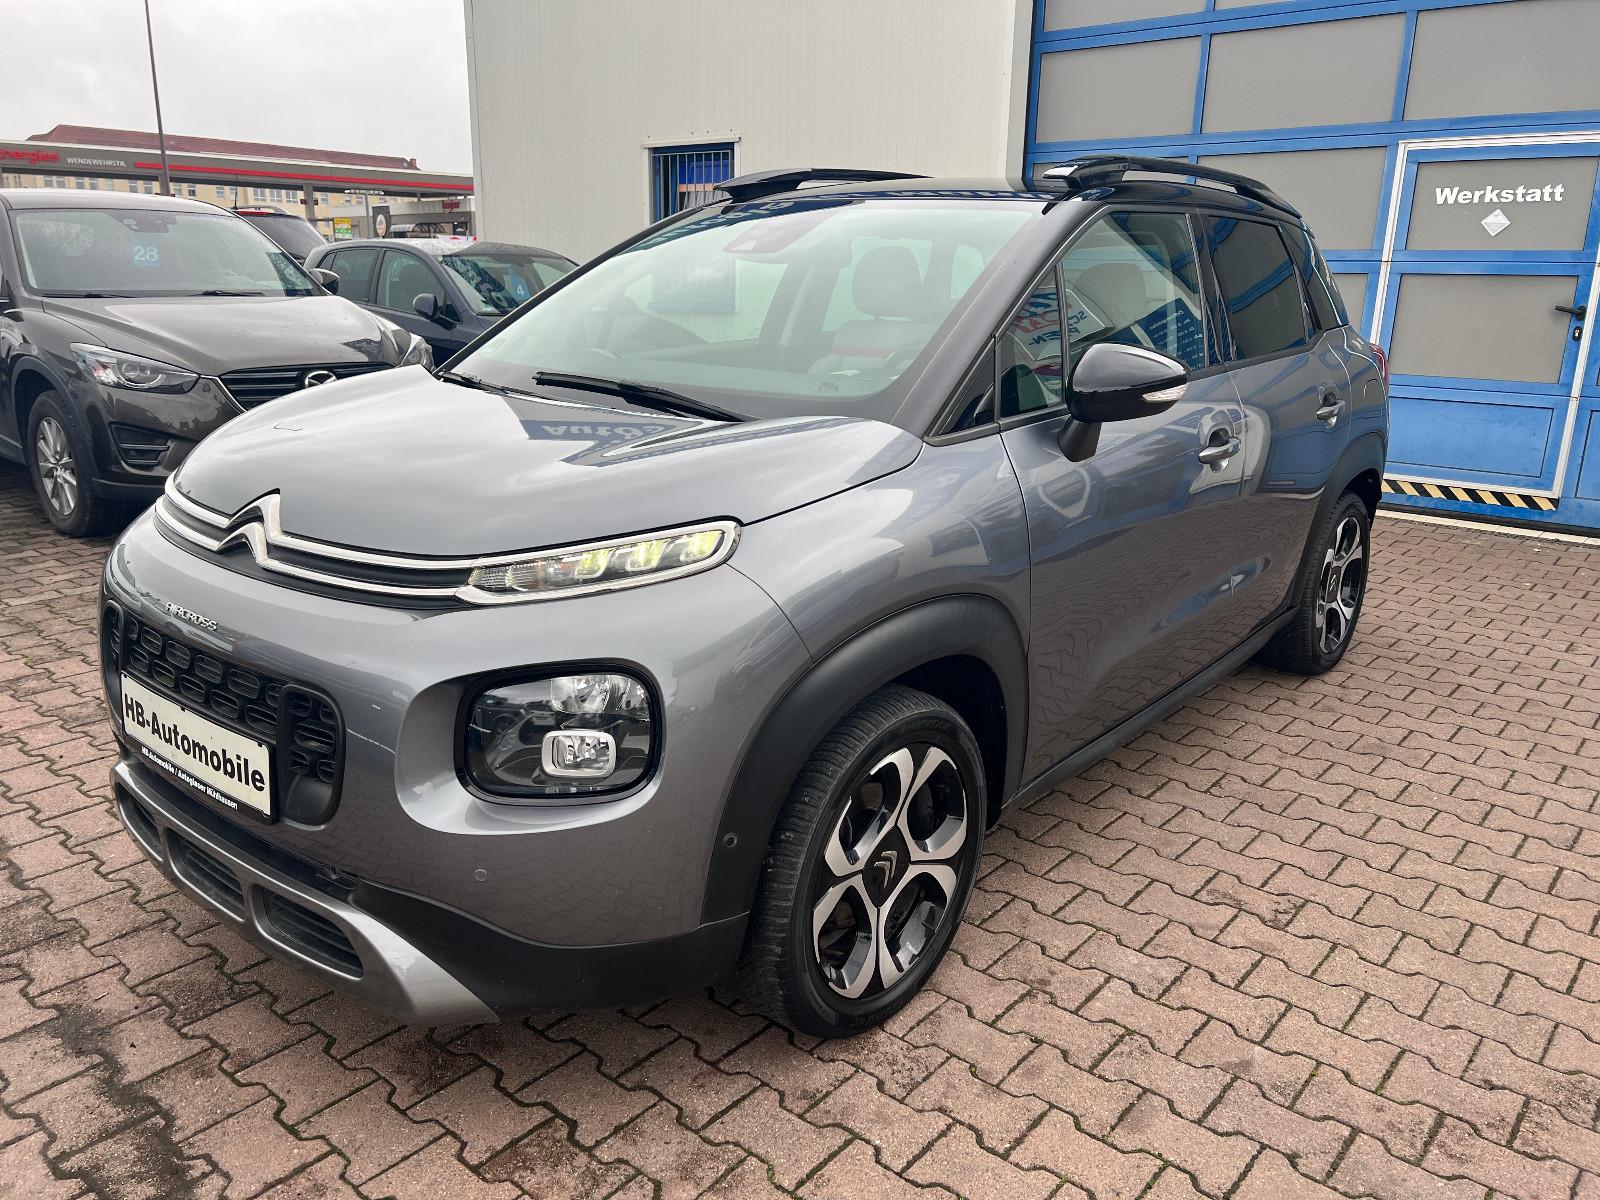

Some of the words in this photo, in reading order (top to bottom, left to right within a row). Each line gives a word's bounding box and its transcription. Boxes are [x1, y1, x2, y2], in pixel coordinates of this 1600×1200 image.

[1435, 184, 1565, 205] Werkstatt
[133, 246, 158, 261] 28
[166, 602, 218, 631] AIRCROSS
[124, 694, 266, 792] HB-Automobile
